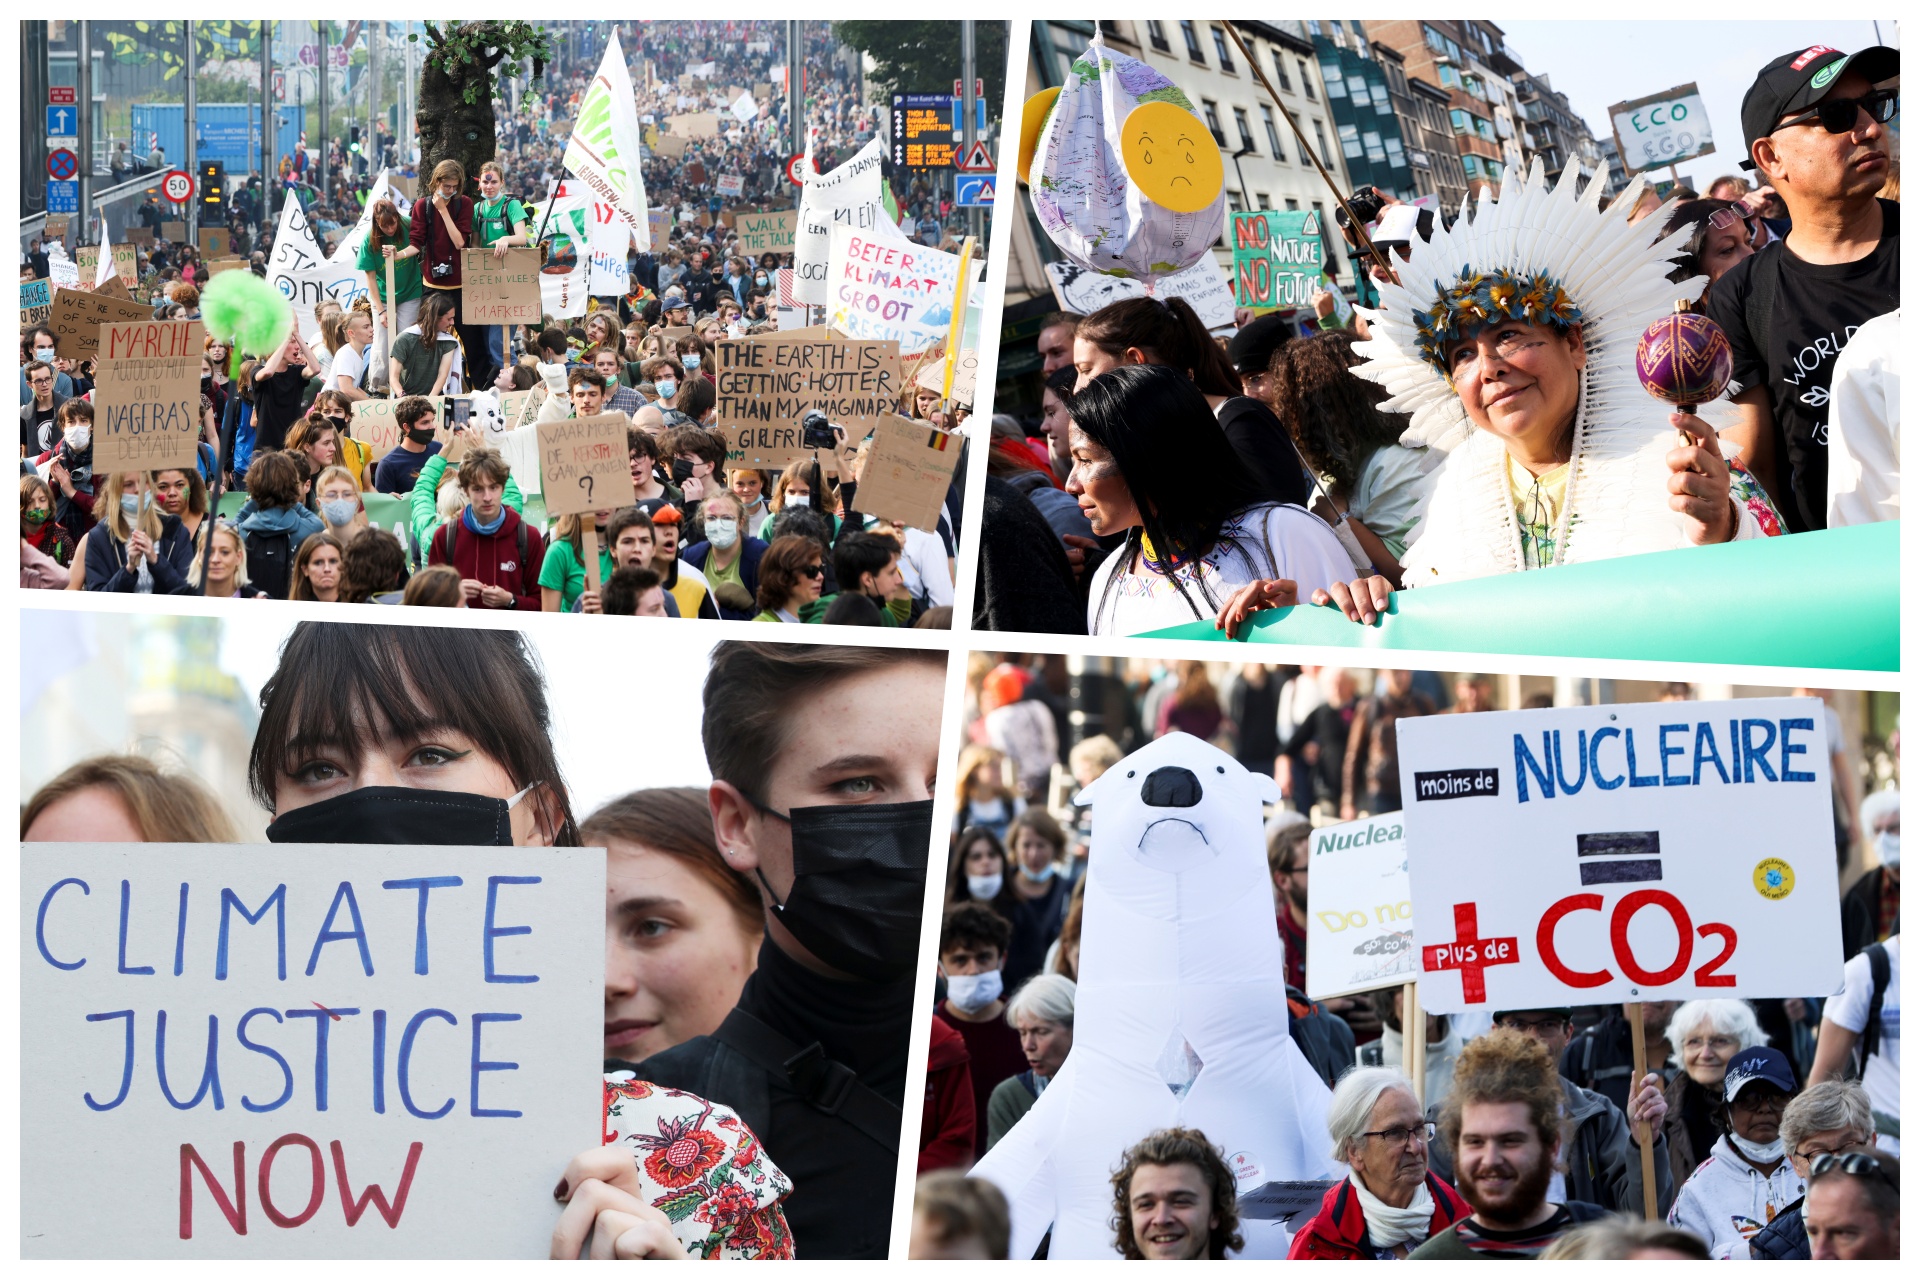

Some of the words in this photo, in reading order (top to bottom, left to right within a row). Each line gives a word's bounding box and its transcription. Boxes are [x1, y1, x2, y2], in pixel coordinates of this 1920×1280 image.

[1632, 104, 1688, 133] ECO
[1642, 132, 1694, 160] EGO
[170, 180, 186, 190] 50
[746, 218, 786, 232] WALK
[808, 223, 827, 235] EEN
[743, 233, 766, 250] THE
[769, 231, 796, 246] TALK
[1235, 215, 1269, 250] NO
[1270, 233, 1319, 265] NATURE
[468, 252, 508, 270] EET
[848, 237, 914, 272] BETER
[51, 263, 76, 271] CHANGE
[469, 275, 502, 285] GEEN
[507, 274, 536, 284] VLEES
[1177, 280, 1200, 294] MAIS
[1205, 275, 1217, 284] ON
[1238, 257, 1270, 305] NO
[20, 282, 49, 306] HANGE
[469, 290, 492, 302] GIJ
[839, 284, 914, 322] GROOT
[62, 295, 108, 314] WE'RE
[118, 308, 142, 319] OUT
[63, 313, 80, 321] OF
[76, 336, 100, 346] SOM
[110, 321, 202, 359] MARCHE
[719, 343, 766, 368] THE
[775, 344, 845, 370] EARTH
[858, 346, 880, 370] IS
[934, 349, 945, 358] US
[134, 385, 146, 400] OU
[150, 385, 160, 399] TU
[719, 372, 801, 394] GETTING
[810, 370, 893, 393] HOTTER
[107, 401, 190, 435] NAGERAS
[718, 396, 771, 422] THAN
[776, 397, 809, 418] MY
[814, 398, 900, 417] IMAGINARY
[541, 424, 585, 444] WAAR
[587, 420, 625, 437] MOET
[739, 428, 813, 449] GIRLFRI
[547, 449, 564, 465] DE
[726, 450, 745, 460] NM
[547, 465, 578, 482] GAAN
[583, 459, 627, 475] WONEN
[579, 476, 593, 504] ?
[1420, 777, 1472, 796] moins
[1474, 770, 1494, 790] de
[1514, 718, 1816, 803] NUCLEAIRE
[1316, 824, 1406, 856] Nuclea
[35, 875, 542, 983] CLIMATE
[1316, 910, 1368, 933] Do
[1385, 941, 1399, 950] CO
[1435, 943, 1477, 967] plus
[1484, 939, 1510, 960] de
[1536, 889, 1737, 989] CO2
[83, 1006, 523, 1119] JUSTICE
[1743, 1058, 1768, 1073] NY
[1238, 1170, 1259, 1179] NUCLEAR
[179, 1133, 423, 1240] NOW
